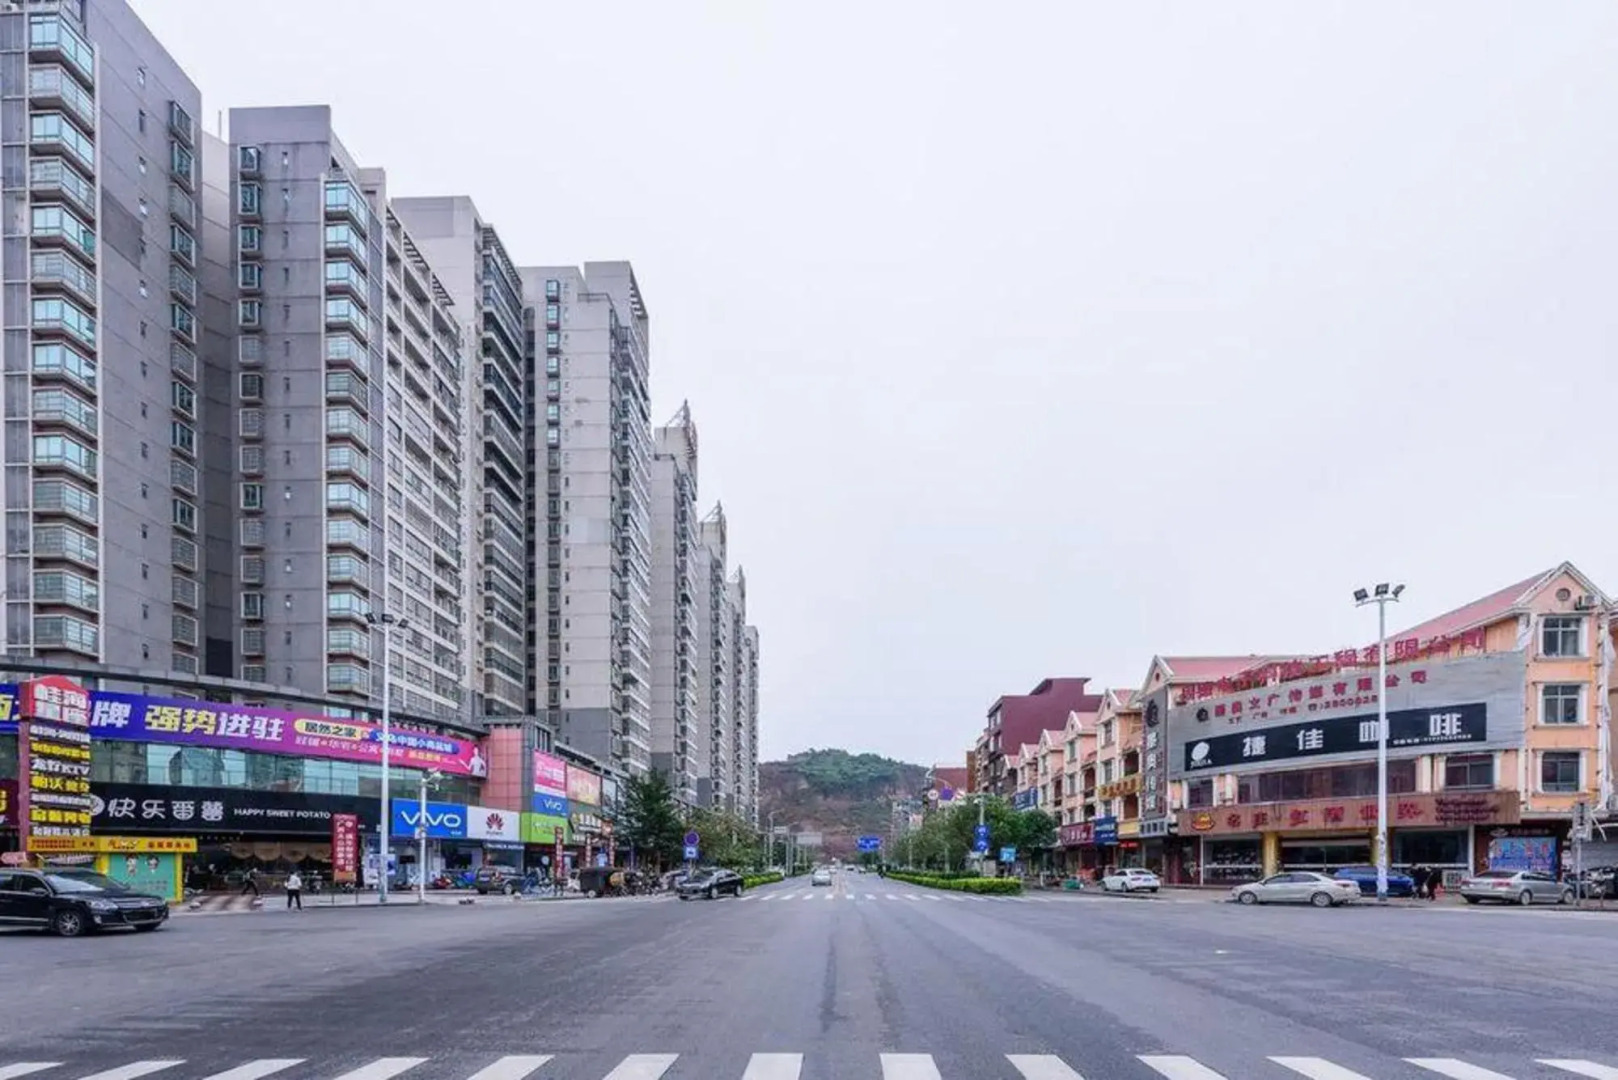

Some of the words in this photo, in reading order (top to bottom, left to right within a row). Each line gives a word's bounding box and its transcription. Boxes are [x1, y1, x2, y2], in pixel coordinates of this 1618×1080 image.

[91, 702, 131, 728] 牌
[145, 705, 284, 741] 强势进驻
[304, 721, 357, 738] 居然之家
[107, 797, 224, 821] 快乐番薯
[234, 808, 265, 817] HAPPY
[266, 809, 295, 818] SWEET
[296, 811, 331, 820] POTATO
